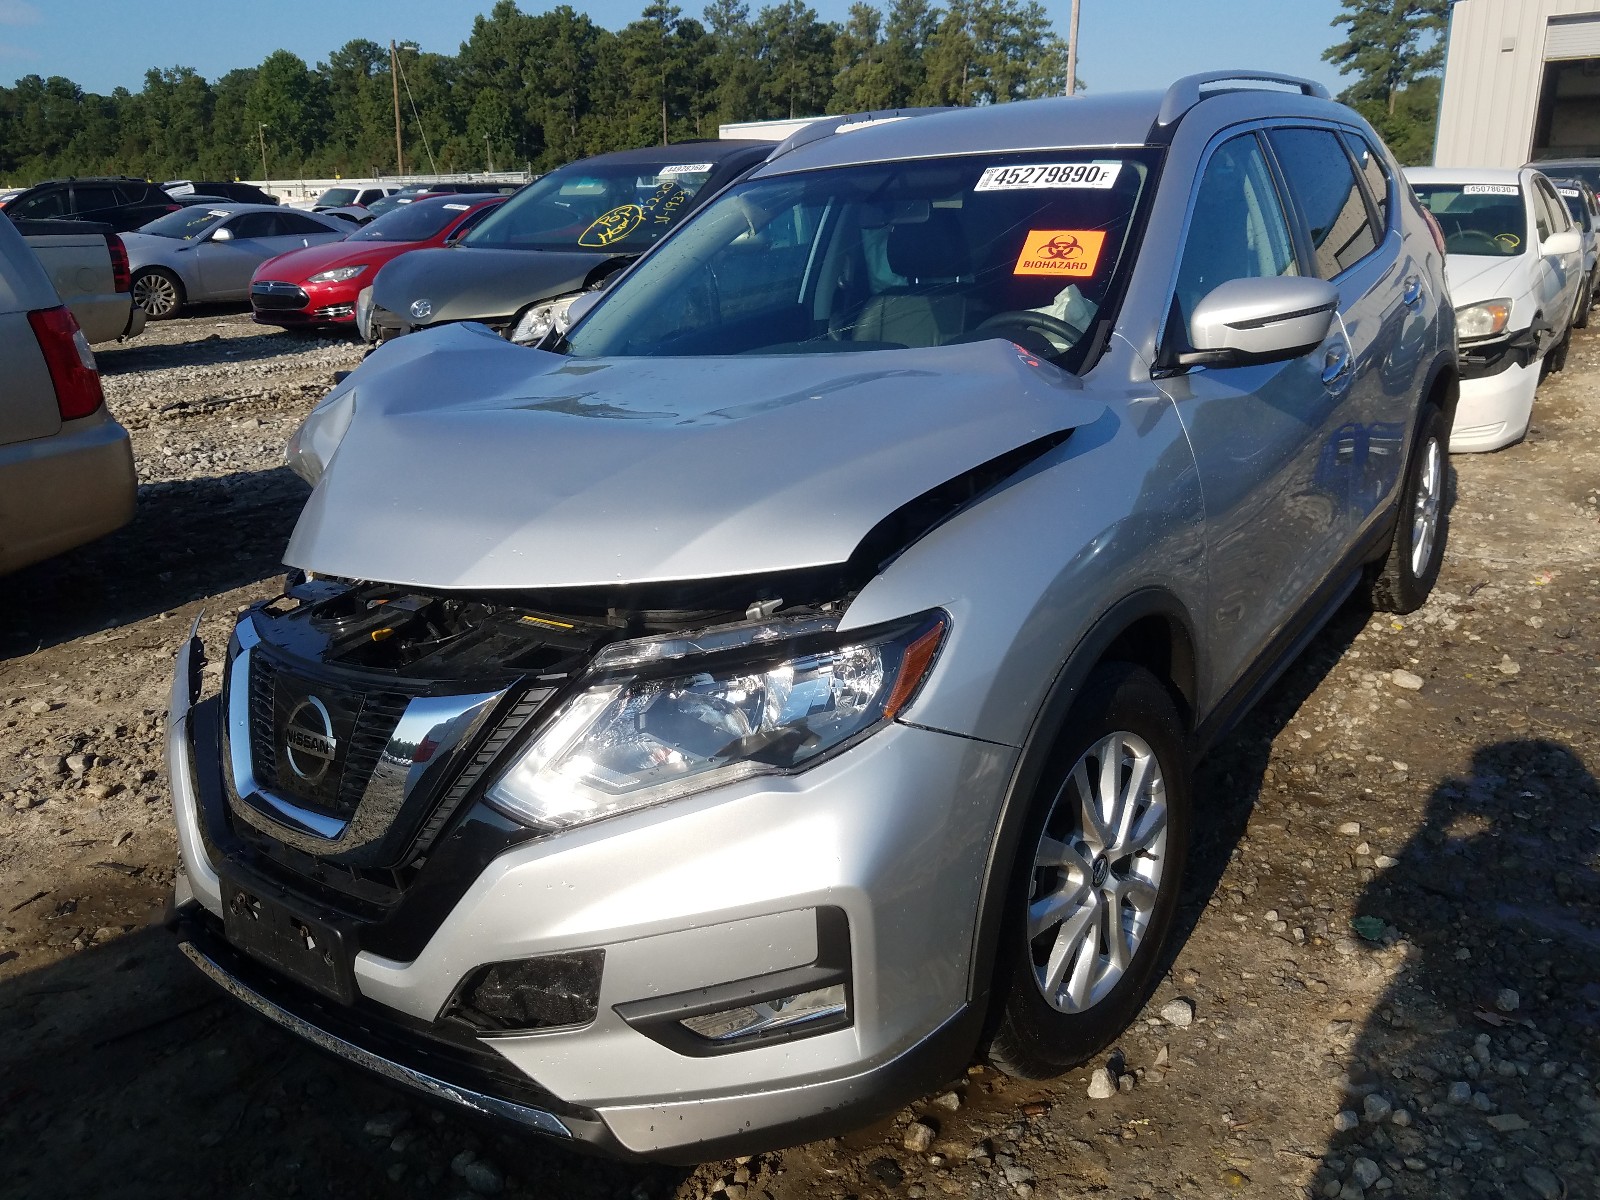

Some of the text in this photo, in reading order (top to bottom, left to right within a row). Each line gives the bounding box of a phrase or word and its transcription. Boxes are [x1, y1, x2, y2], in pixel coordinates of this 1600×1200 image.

[994, 165, 1101, 186] 45279890
[1022, 260, 1088, 270] BIOHAZARD
[285, 727, 329, 755] NISSAN
